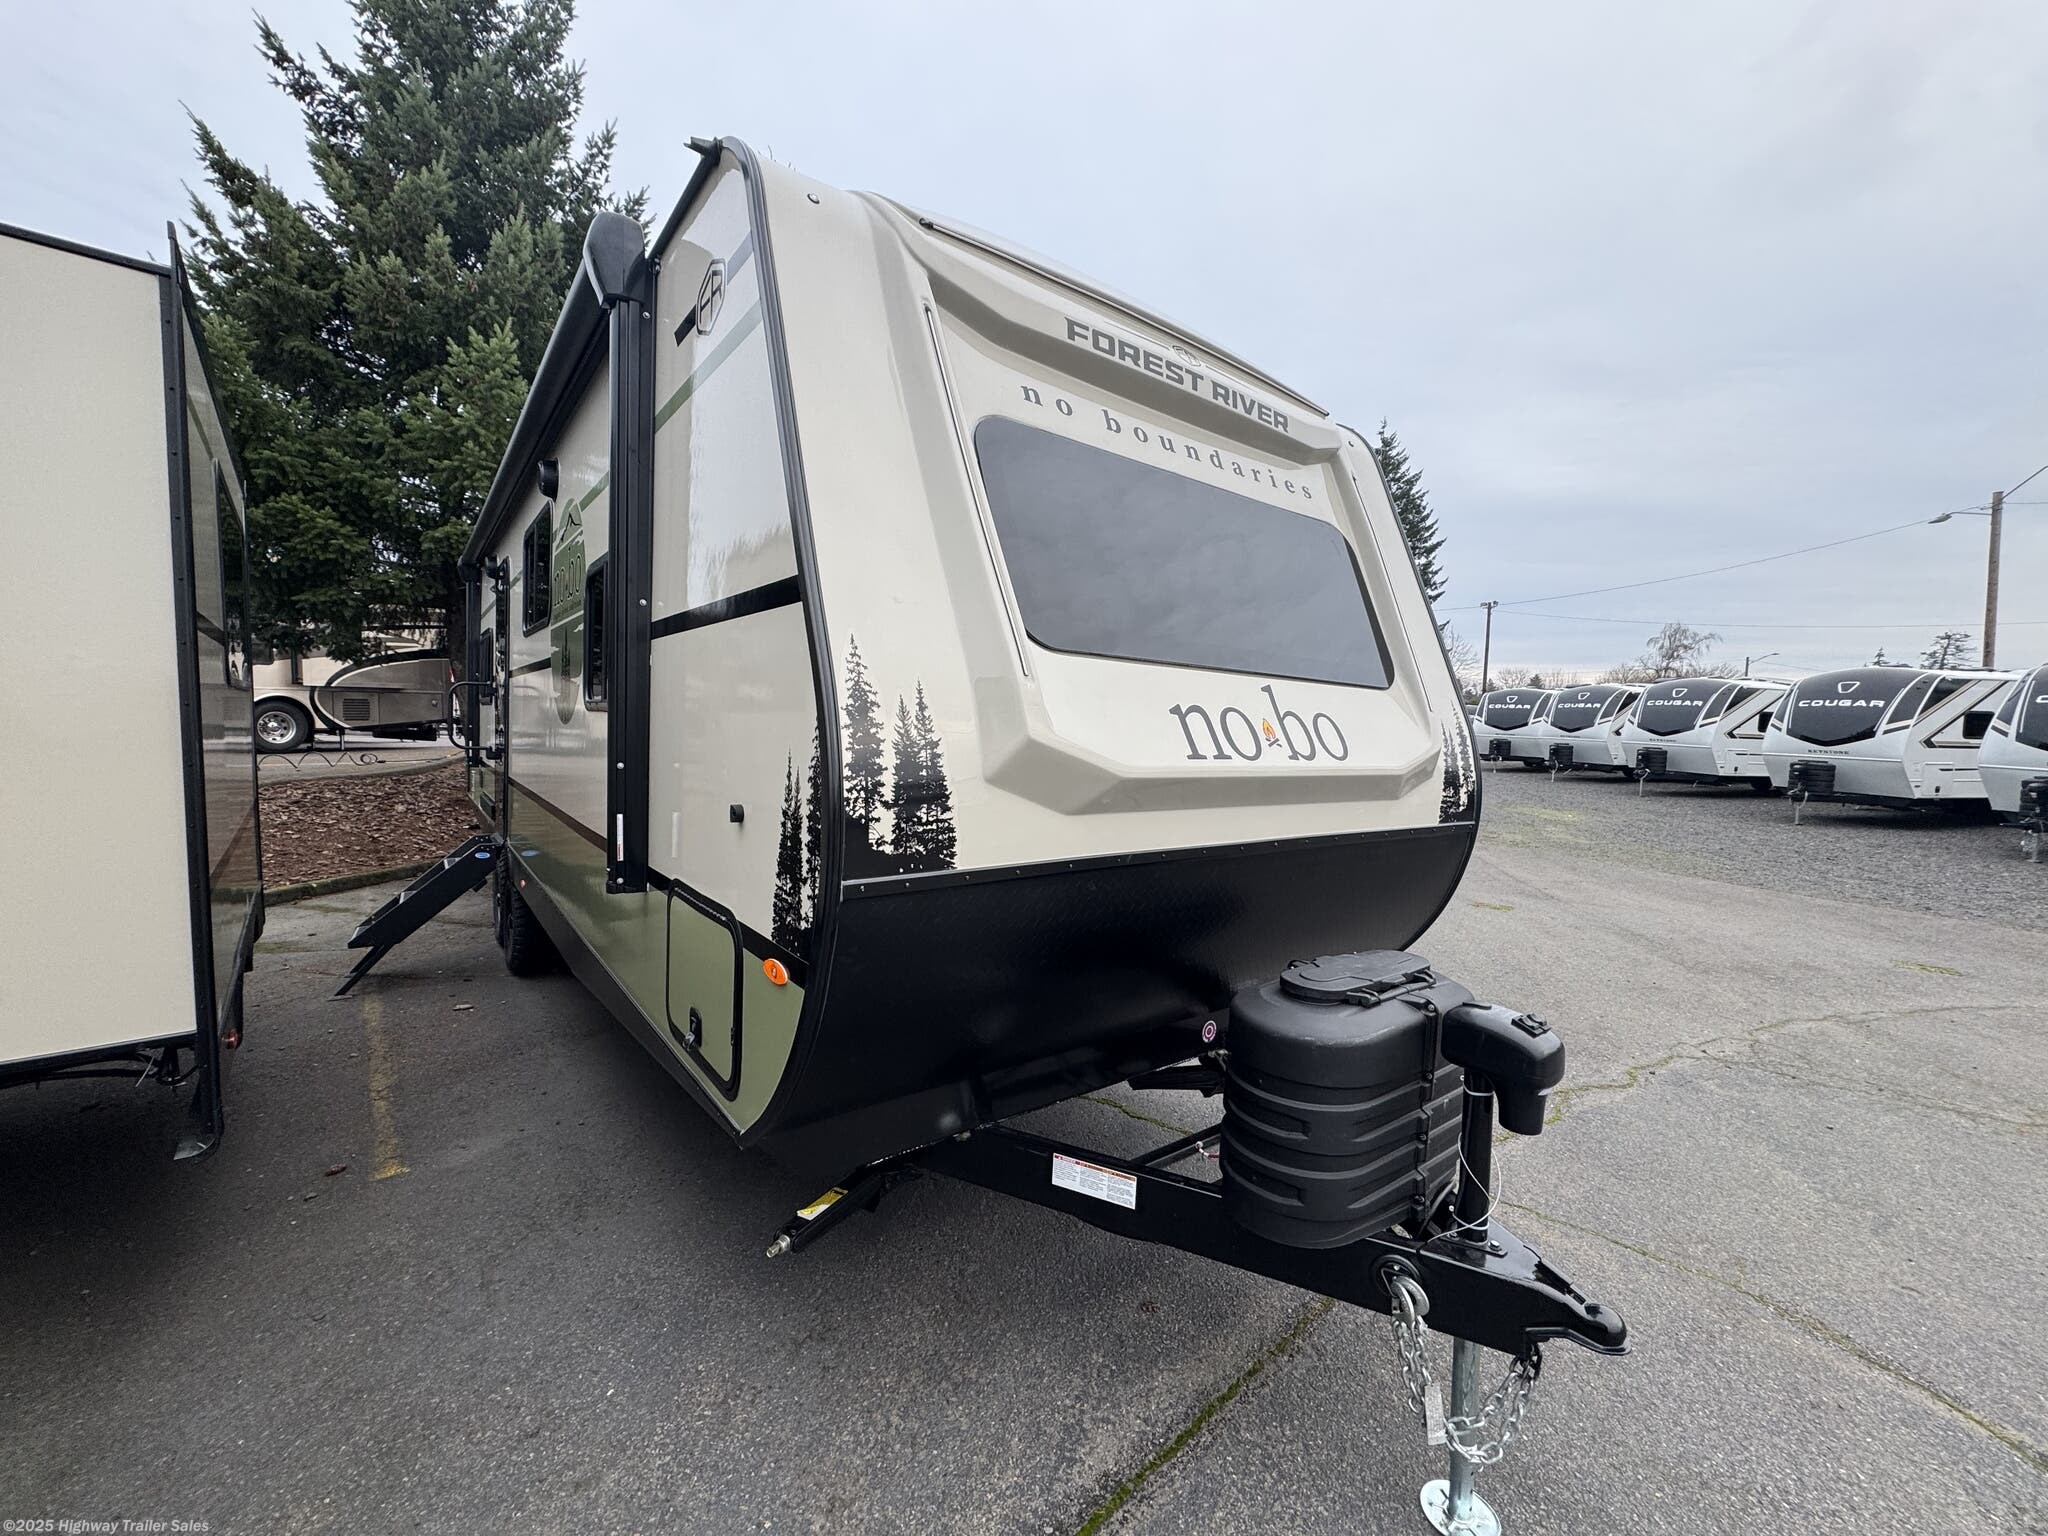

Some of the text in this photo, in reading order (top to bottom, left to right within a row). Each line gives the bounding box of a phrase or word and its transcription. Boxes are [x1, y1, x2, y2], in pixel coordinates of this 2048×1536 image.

[1064, 316, 1289, 434] FOREST RIVER
[1020, 385, 1313, 500] no boundaries
[1646, 699, 1704, 707] COUGAR
[1798, 699, 1886, 708] COUGAR
